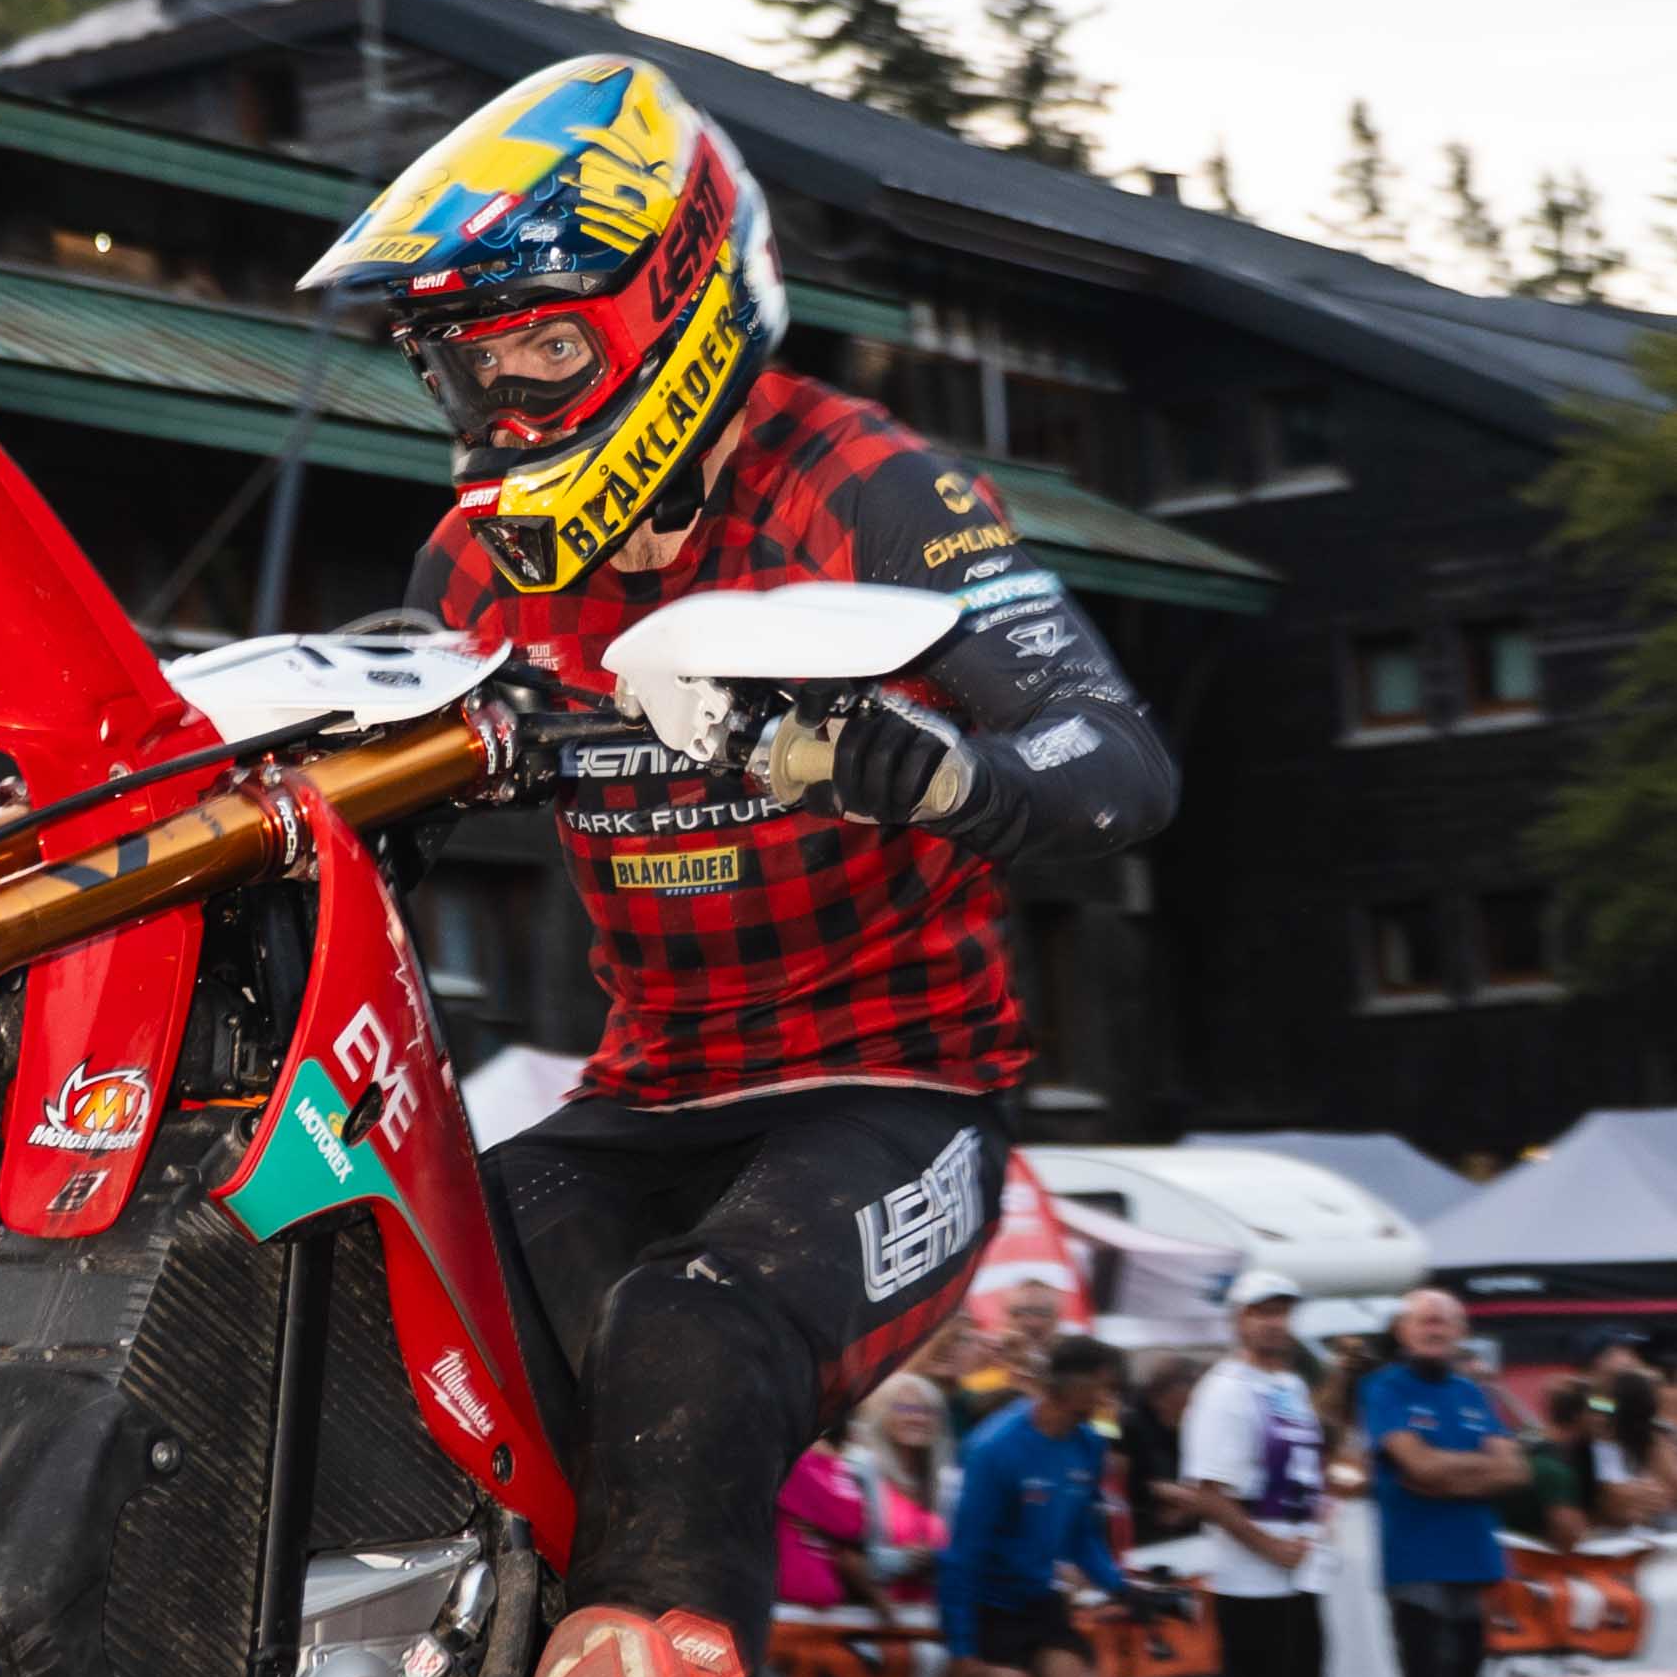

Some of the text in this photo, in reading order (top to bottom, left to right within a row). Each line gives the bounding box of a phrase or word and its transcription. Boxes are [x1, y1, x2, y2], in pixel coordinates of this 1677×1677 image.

[923, 525, 1016, 569] ÖHLIN
[616, 854, 734, 885] BLÅKLÄDER
[294, 1097, 353, 1184] MOTOREX
